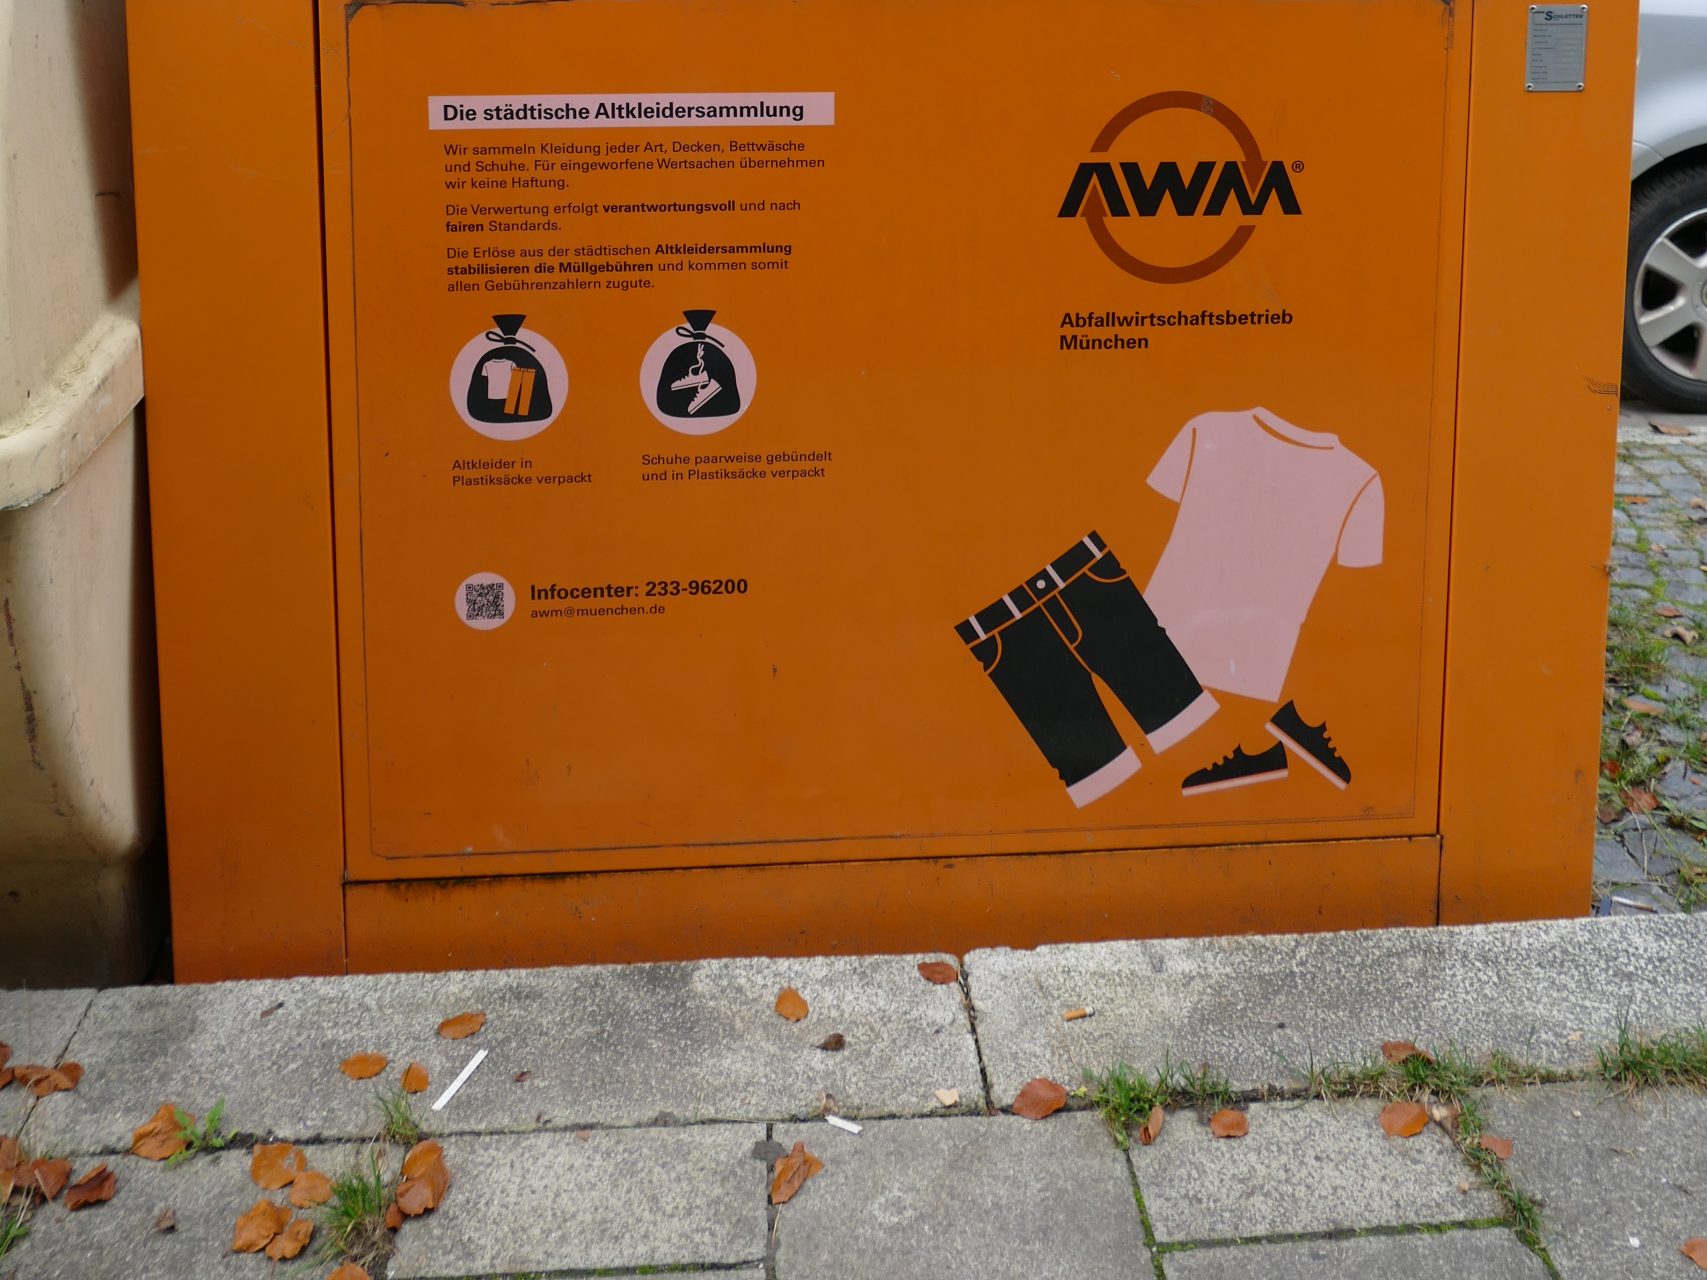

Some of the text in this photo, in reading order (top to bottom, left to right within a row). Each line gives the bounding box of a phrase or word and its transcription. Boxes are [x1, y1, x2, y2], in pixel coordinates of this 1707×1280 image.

[444, 101, 803, 121] Die städtische Altkleidersammlung
[444, 141, 805, 156] Wir sammeln Kleidung jeder Art, Decken, Bettwäsche
[445, 157, 824, 173] und Schuhe. Für eingeworfene Wertsachen übernehmen
[445, 177, 568, 190] wir keine Haftung.
[446, 200, 800, 216] Die Verwertung erfolgt verantwortungsvoll und nach
[446, 220, 561, 232] fairen Standards.
[447, 243, 791, 258] Die Erlöse aus der städtischen Altkleidersammlung
[447, 259, 788, 275] stabilisieren die Müllgebühren und kommen somit
[448, 279, 654, 292] allen Gebührenzahlern zugute.
[1060, 309, 1293, 328] Abfallwirtschaftsbetrieb
[1060, 334, 1148, 350] München
[452, 458, 532, 470] Altkleider in
[642, 451, 832, 467] Schuhe paarweise gebündelt
[453, 472, 592, 486] Plastiksäcke verpackt
[642, 464, 824, 481] und in Plastiksäcke verpackt
[531, 579, 747, 600] Infocenter: 233-96200
[531, 604, 665, 618] awm@muenchen.de
